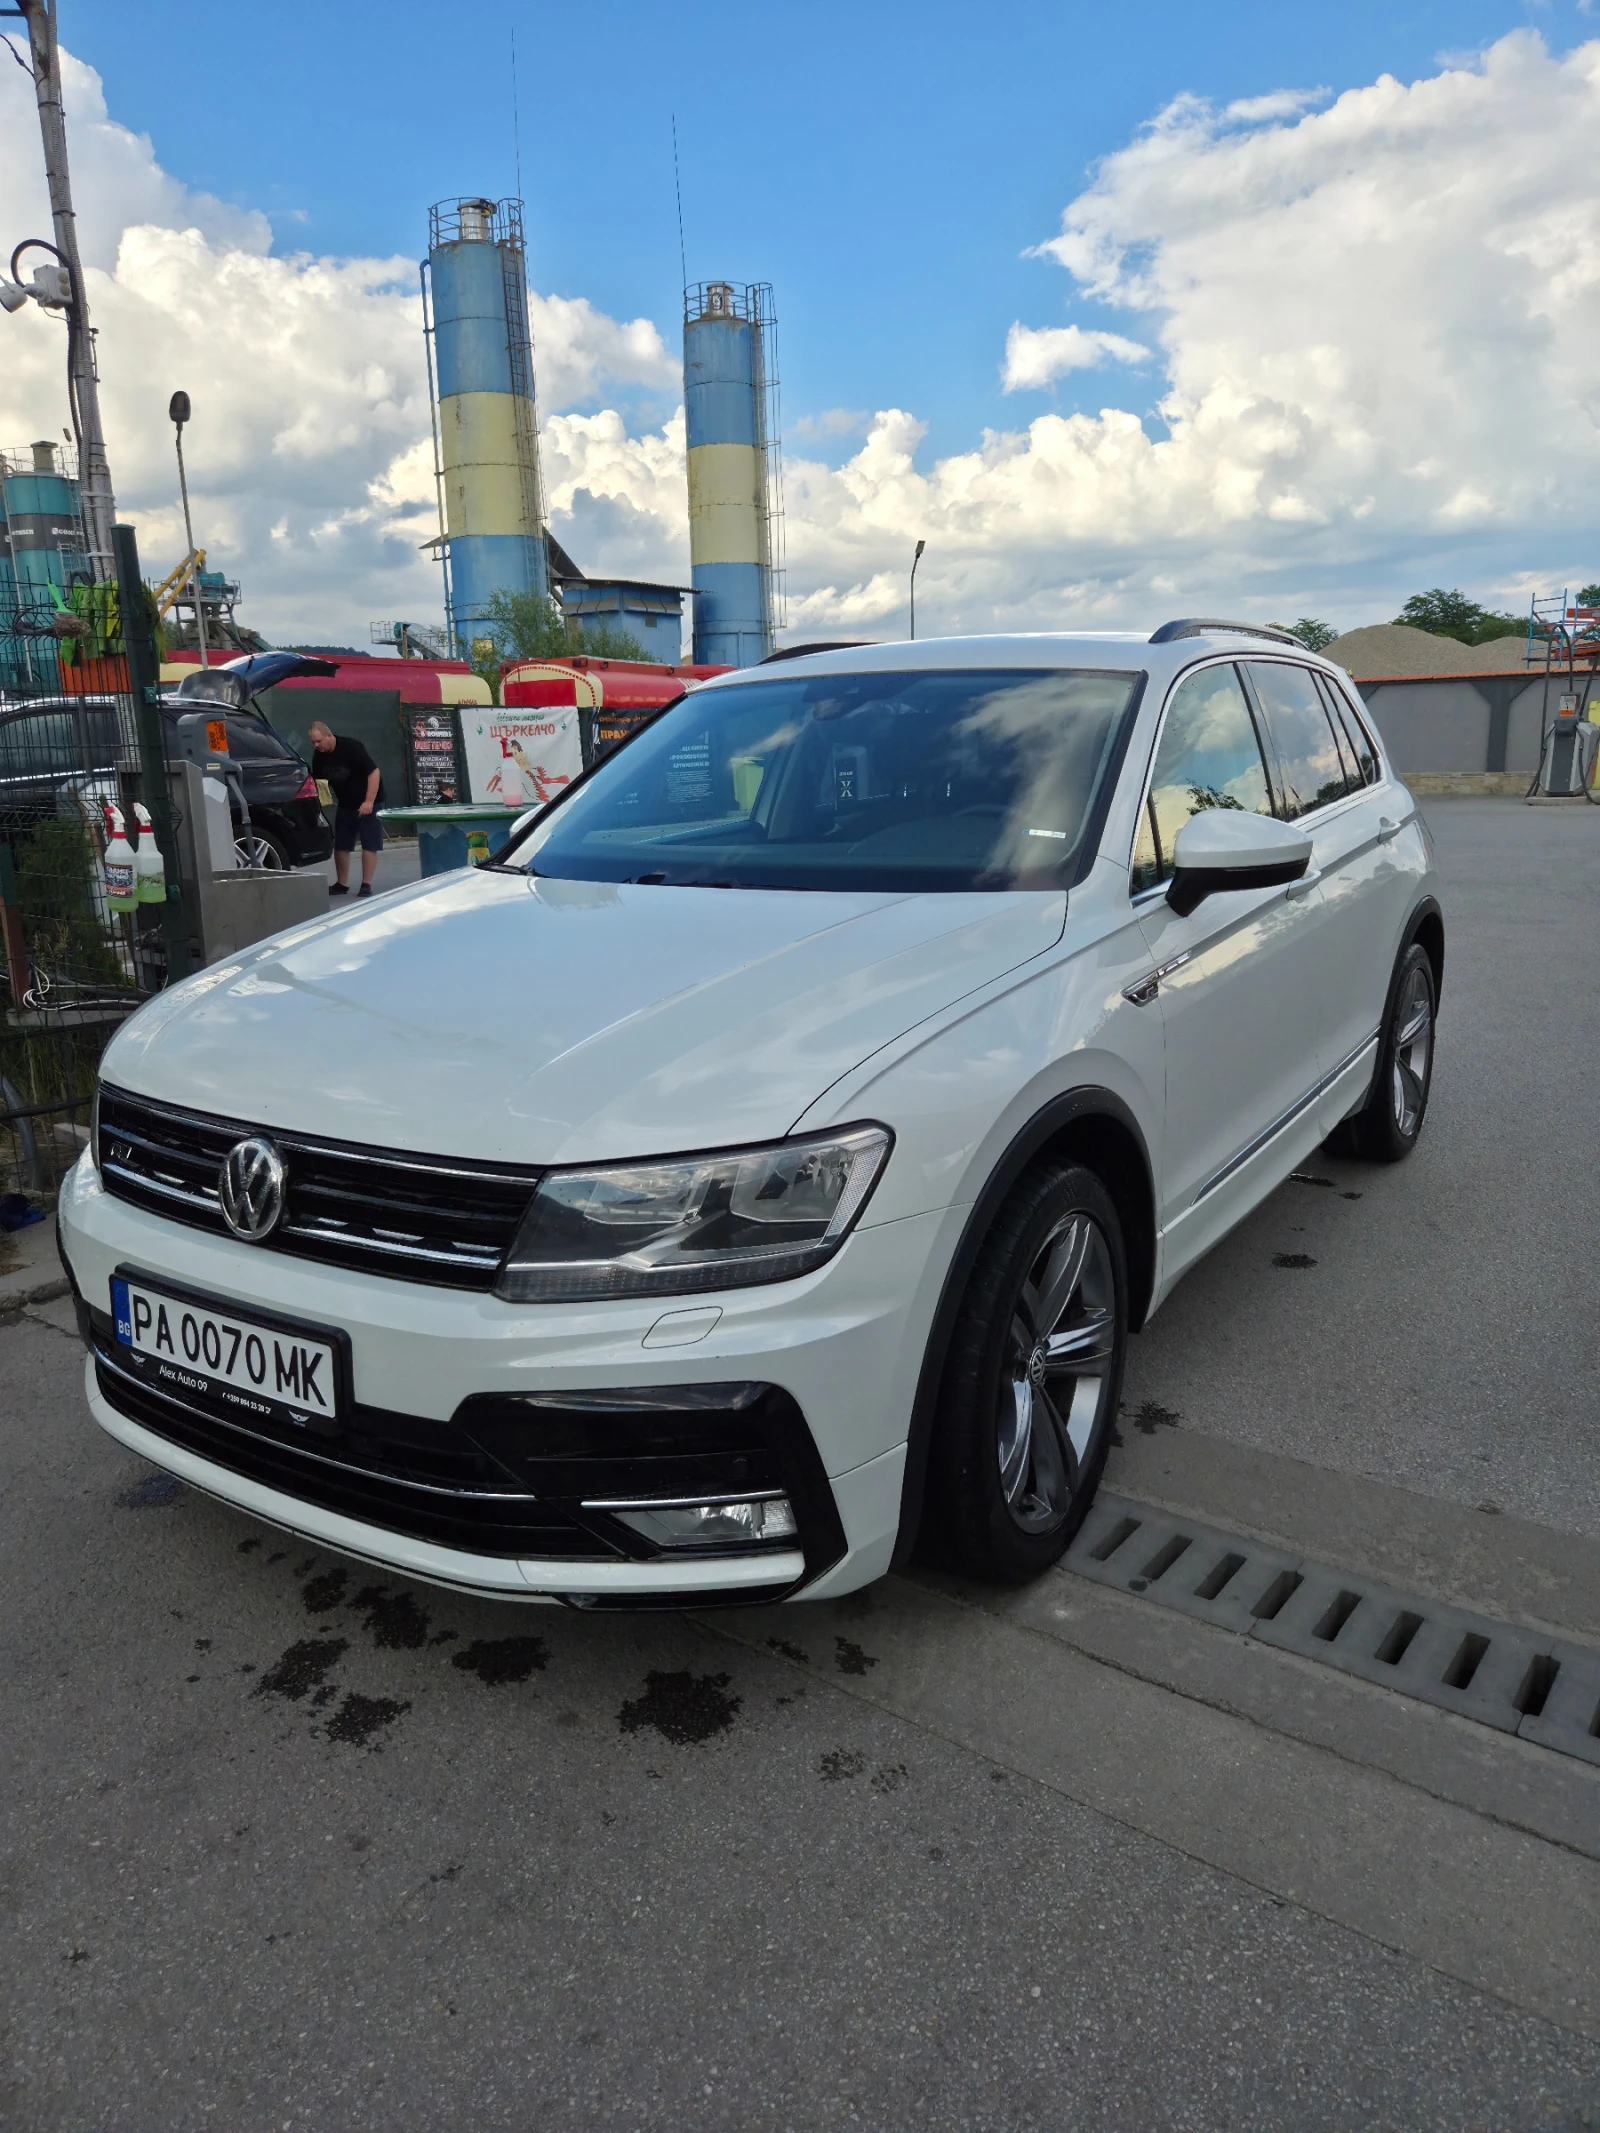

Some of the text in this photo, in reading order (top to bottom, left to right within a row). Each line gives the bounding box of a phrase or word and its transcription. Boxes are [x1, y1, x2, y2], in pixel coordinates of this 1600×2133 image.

[489, 722, 556, 738] ЩЪРКЕЛЧО
[118, 1319, 131, 1337] BG
[132, 1293, 327, 1407] PA 0070 MK
[159, 1364, 208, 1392] Alex Auto 09
